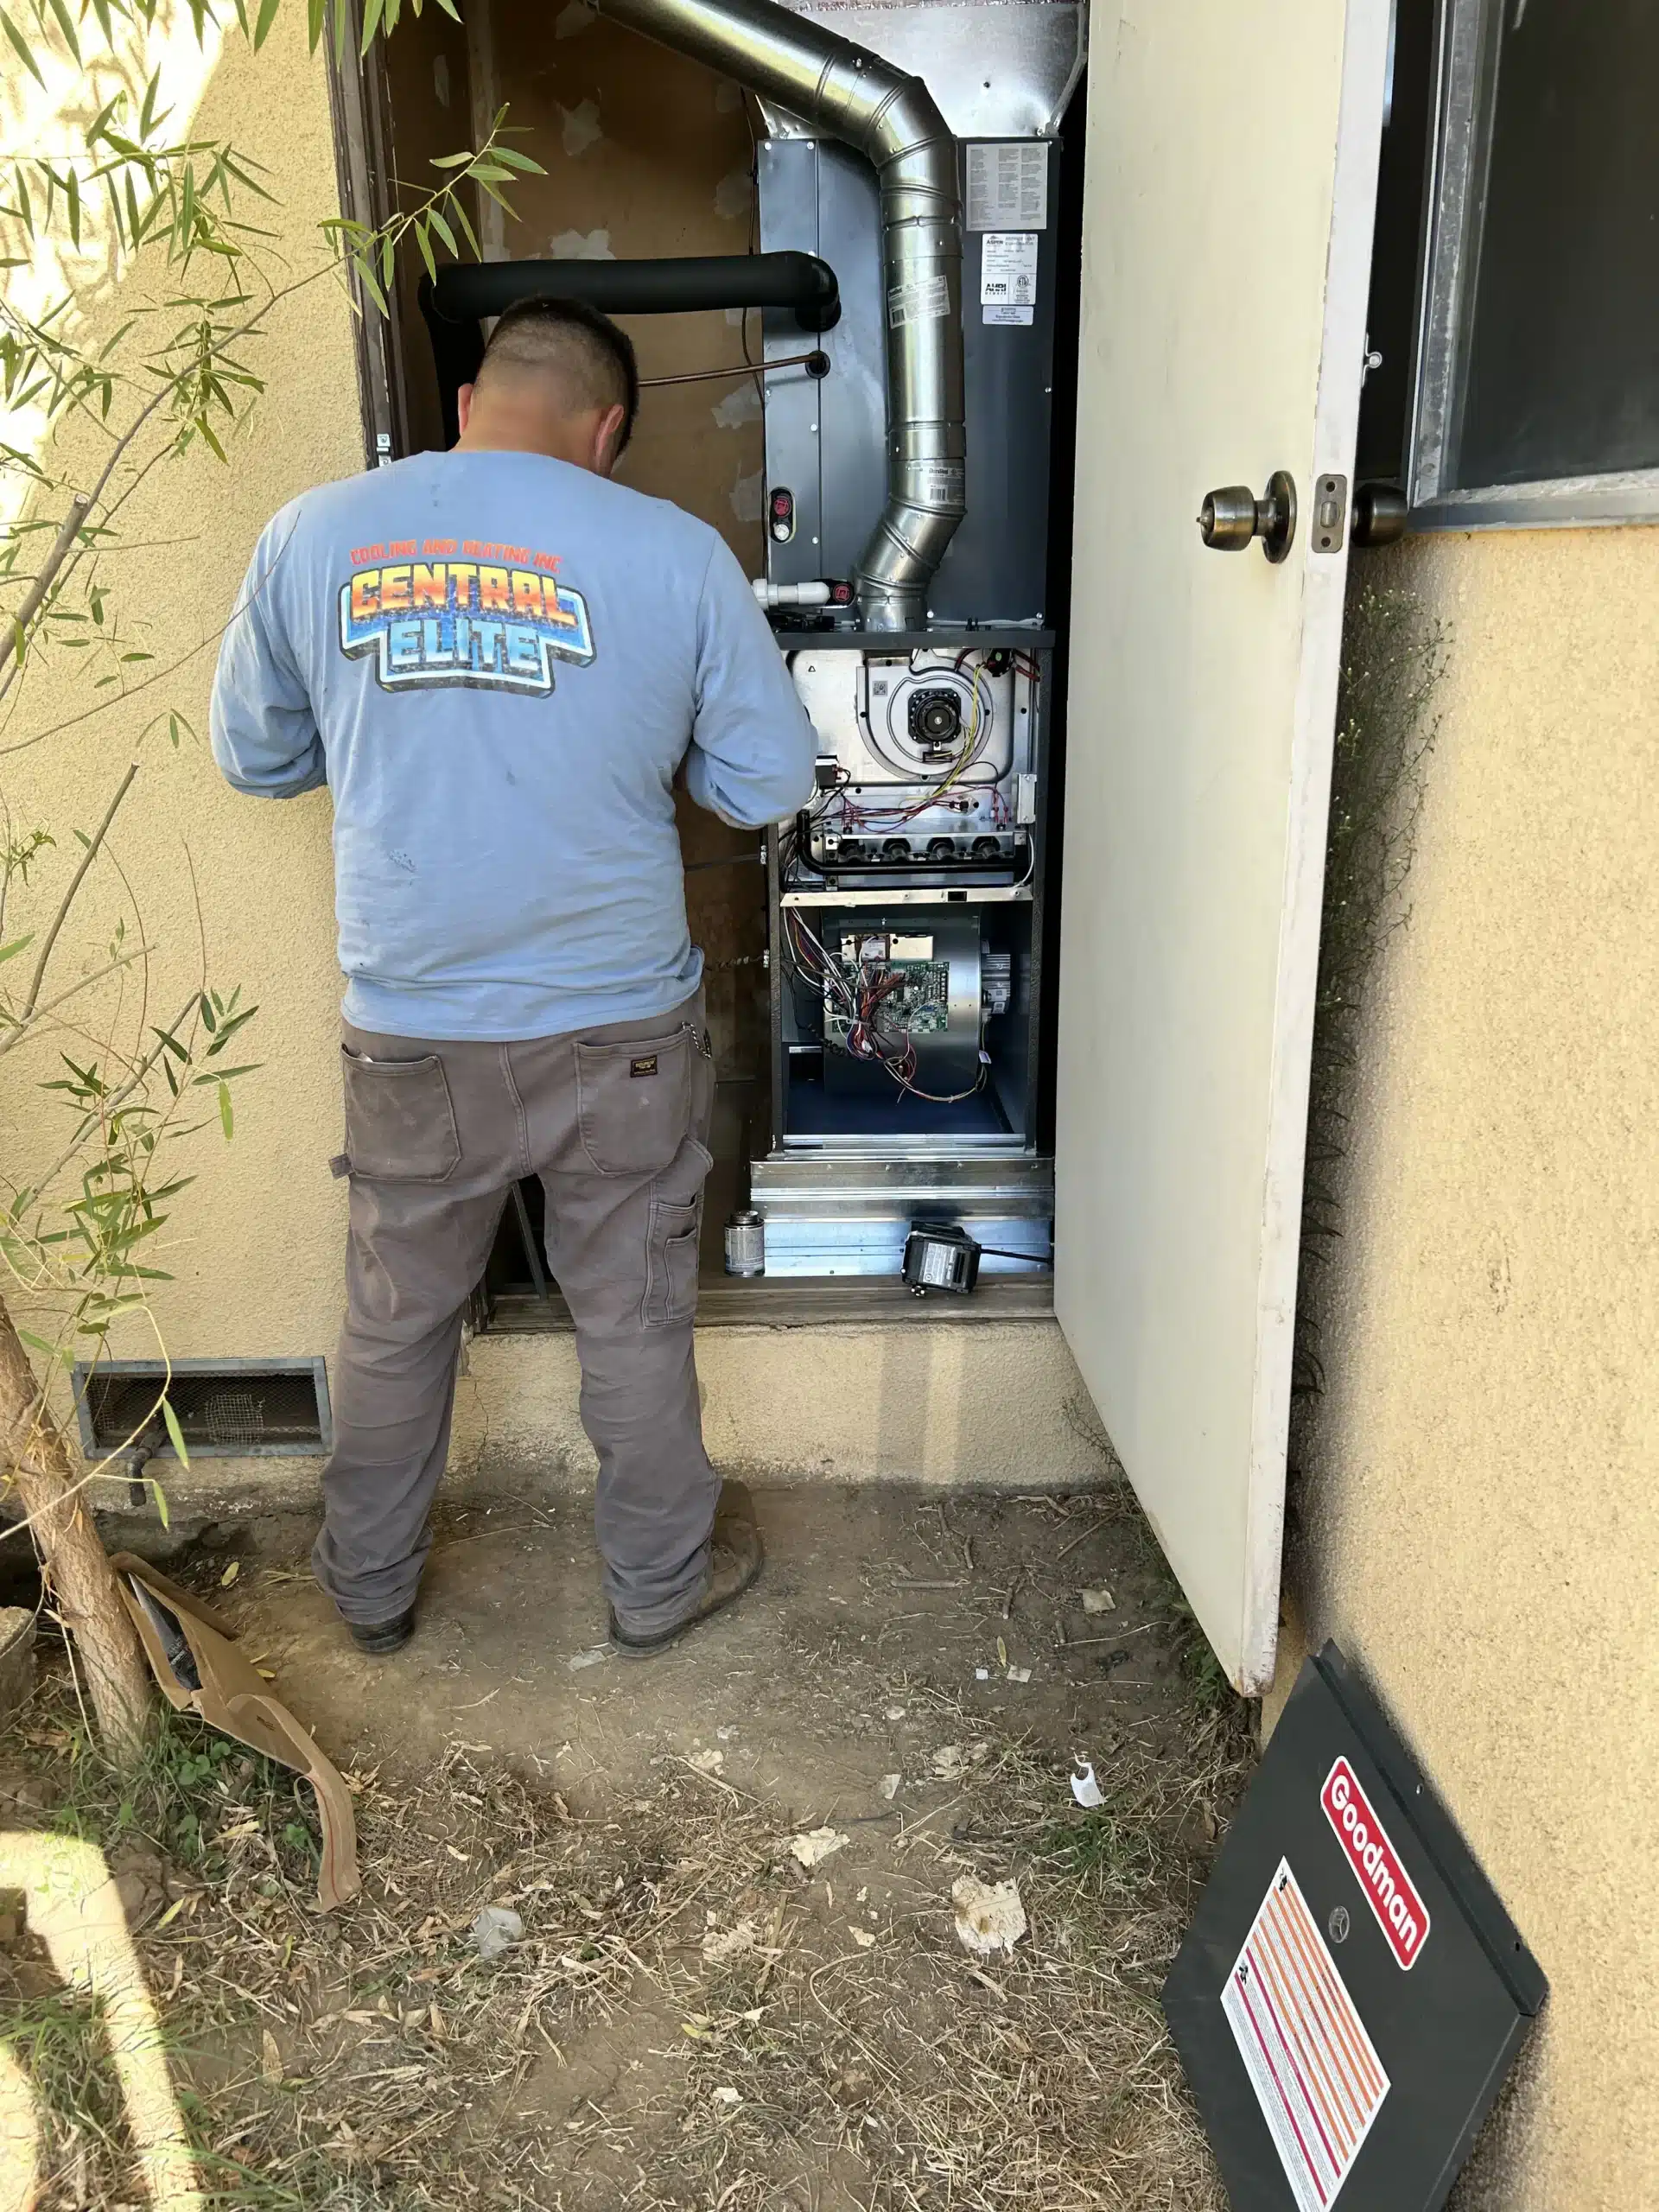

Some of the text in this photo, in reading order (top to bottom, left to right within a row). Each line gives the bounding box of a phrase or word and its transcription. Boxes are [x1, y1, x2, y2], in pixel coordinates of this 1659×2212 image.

[351, 539, 417, 565] COOLING
[422, 538, 457, 555] AND
[462, 540, 531, 564] HEATING
[351, 563, 577, 626] CENTRAL
[390, 620, 539, 671] ELITE
[1332, 1775, 1417, 1952] Goodman
